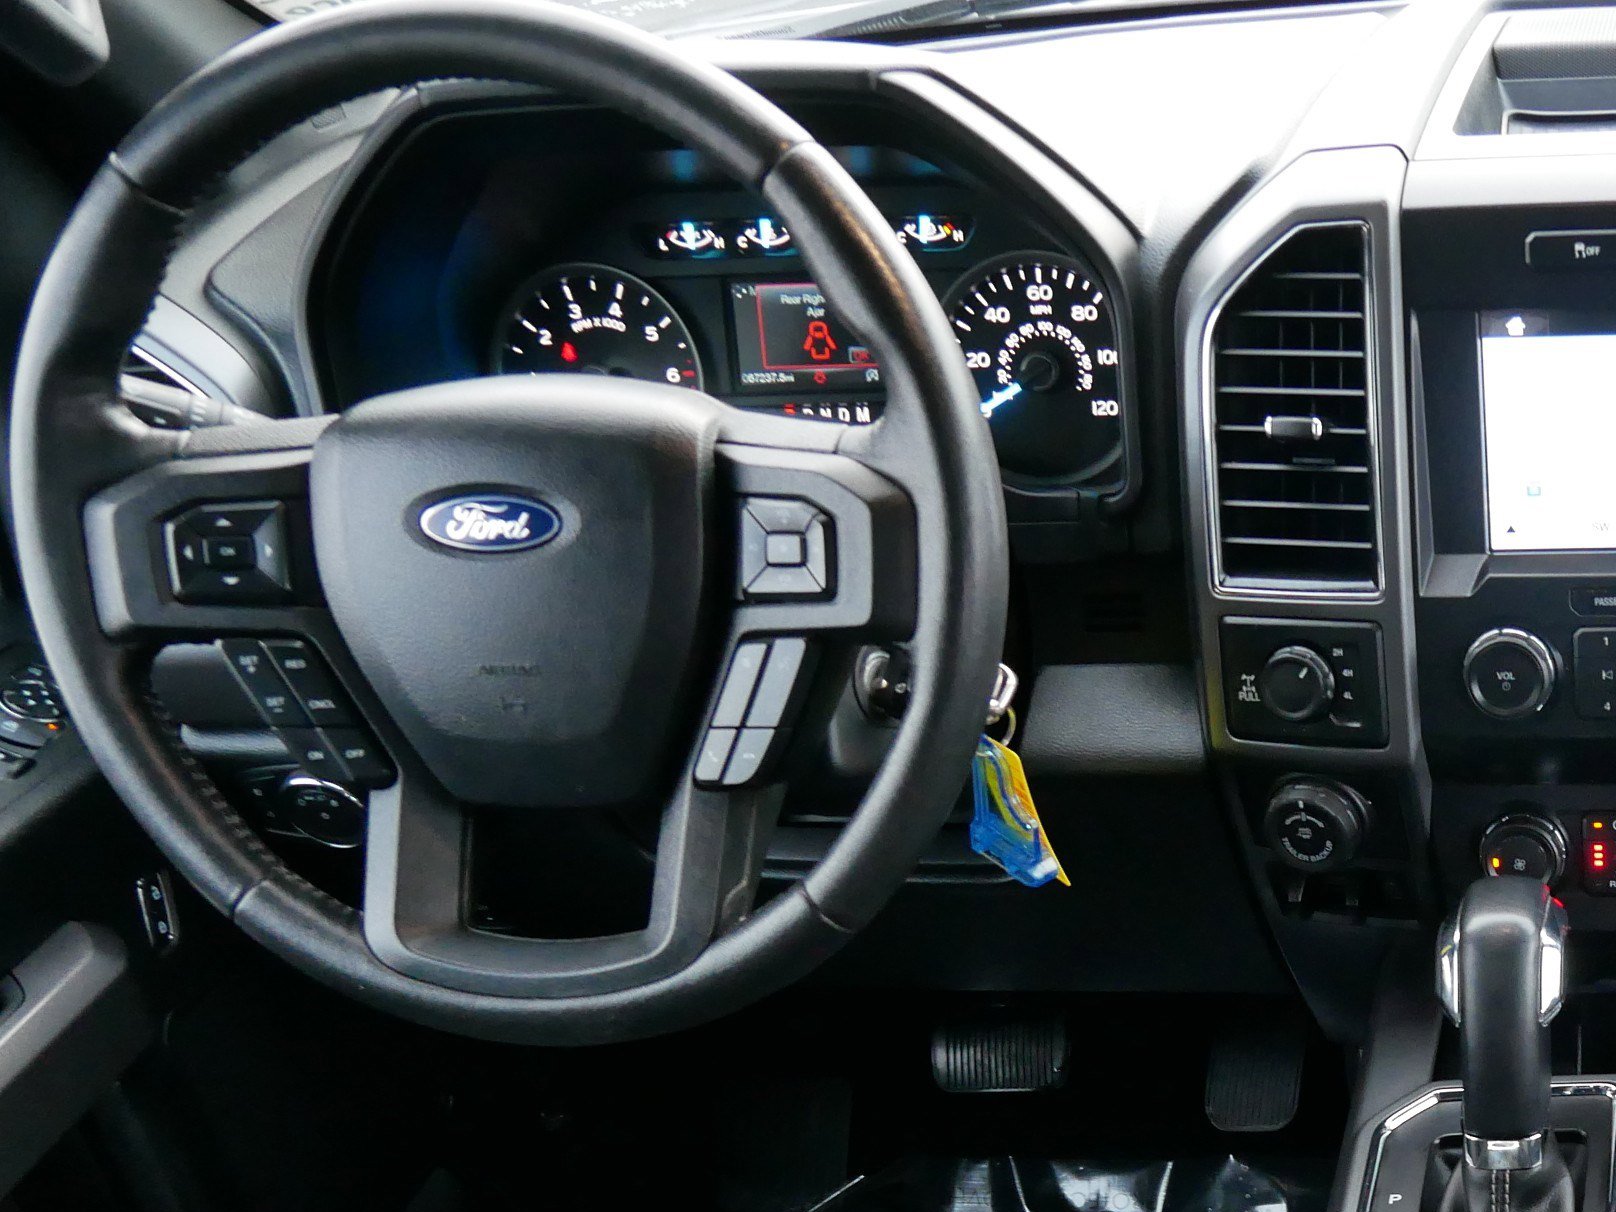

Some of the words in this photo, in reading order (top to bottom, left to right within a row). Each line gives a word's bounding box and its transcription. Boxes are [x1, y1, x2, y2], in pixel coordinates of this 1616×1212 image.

[1585, 245, 1601, 257] OFF
[1026, 285, 1053, 301] 60
[568, 303, 583, 320] 3
[608, 302, 623, 318] 4
[984, 307, 1011, 324] 40
[1029, 305, 1053, 315] MPH
[1071, 305, 1098, 321] 80
[539, 329, 553, 346] 2
[644, 326, 659, 342] 5
[966, 352, 991, 368] 20
[666, 367, 681, 383] 6
[855, 406, 871, 423] M
[1091, 400, 1119, 416] 120
[446, 502, 530, 541] Ford
[1603, 636, 1609, 646] 1
[1496, 671, 1516, 681] VOL
[1238, 691, 1261, 701] PULL
[1604, 701, 1611, 711] 4
[1388, 1194, 1402, 1204] P
